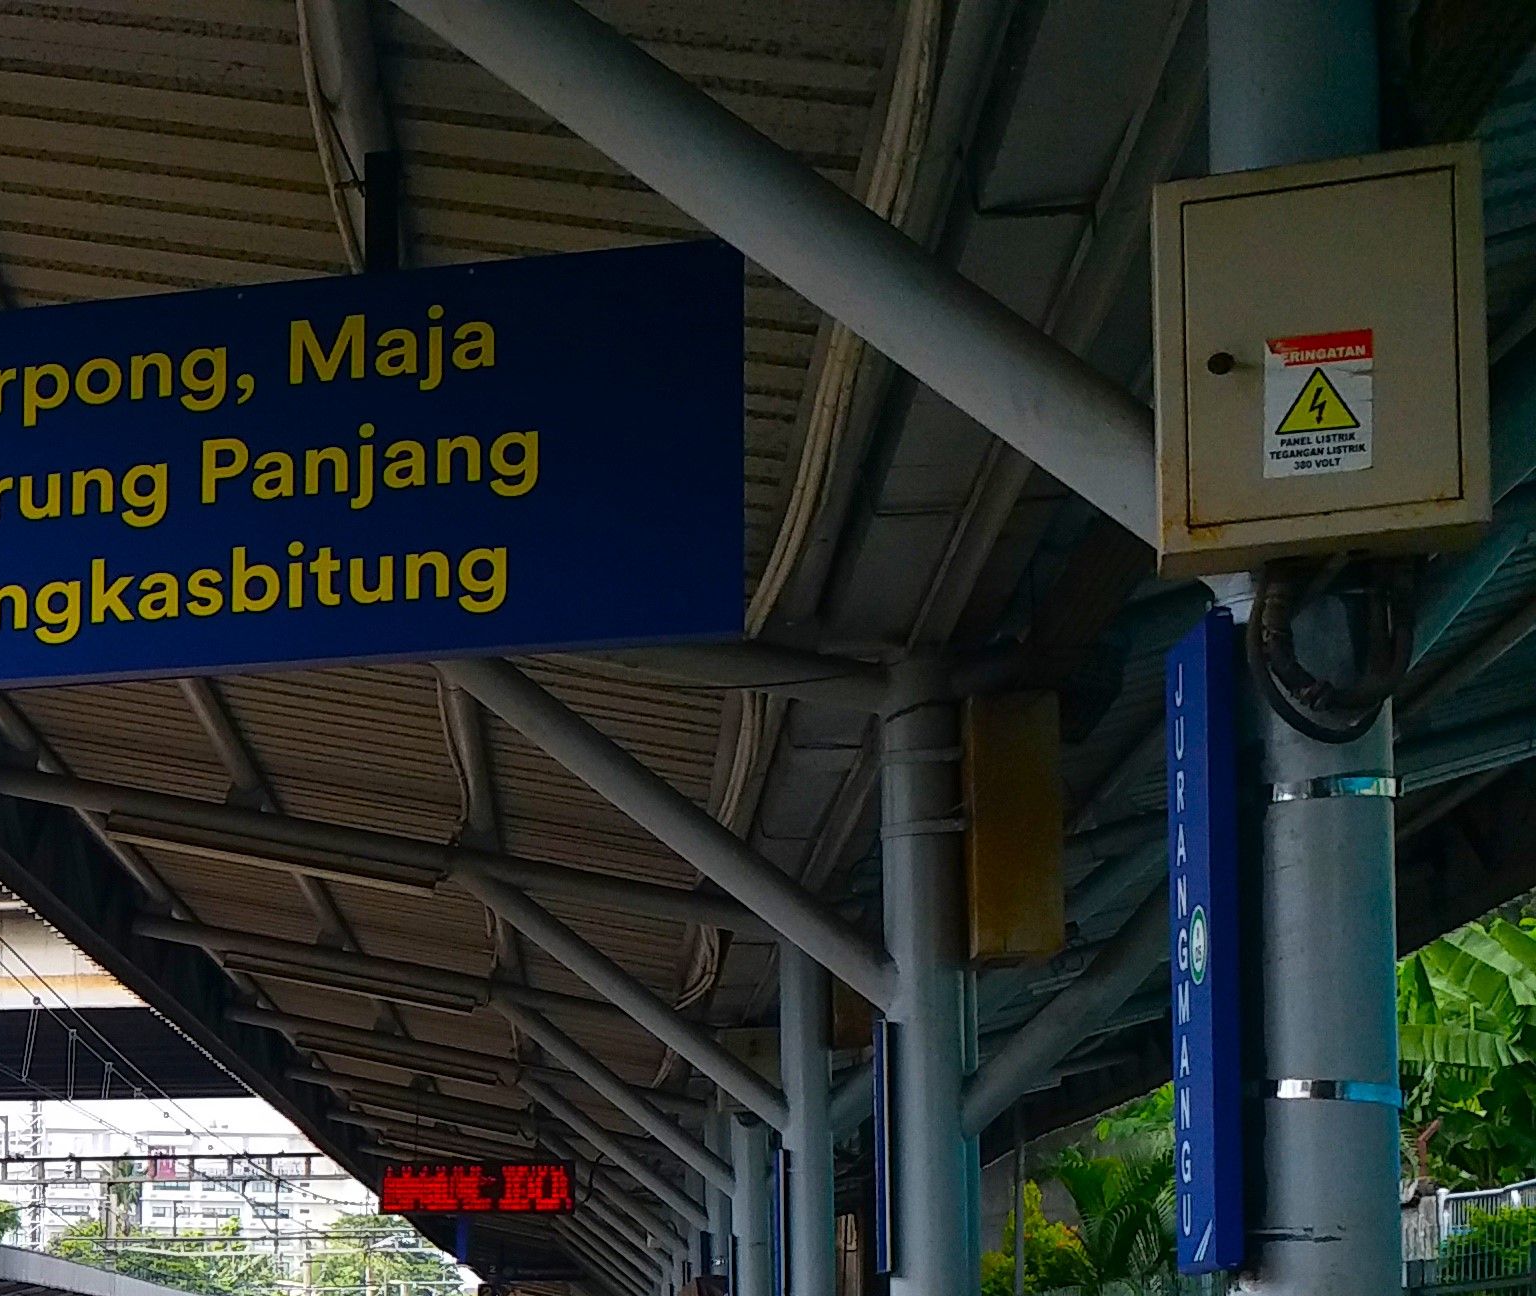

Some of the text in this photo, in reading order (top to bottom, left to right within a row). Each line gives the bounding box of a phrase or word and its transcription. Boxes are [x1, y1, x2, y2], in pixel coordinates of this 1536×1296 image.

[289, 304, 496, 391] Maja
[1270, 443, 1366, 460] TEGANGAN LISTRIK
[1280, 432, 1356, 448] PANEL LISTRIK
[1294, 457, 1341, 470] 380 VOLT
[201, 423, 540, 509] Panjang
[1174, 662, 1193, 1237] JURANGMANGU
